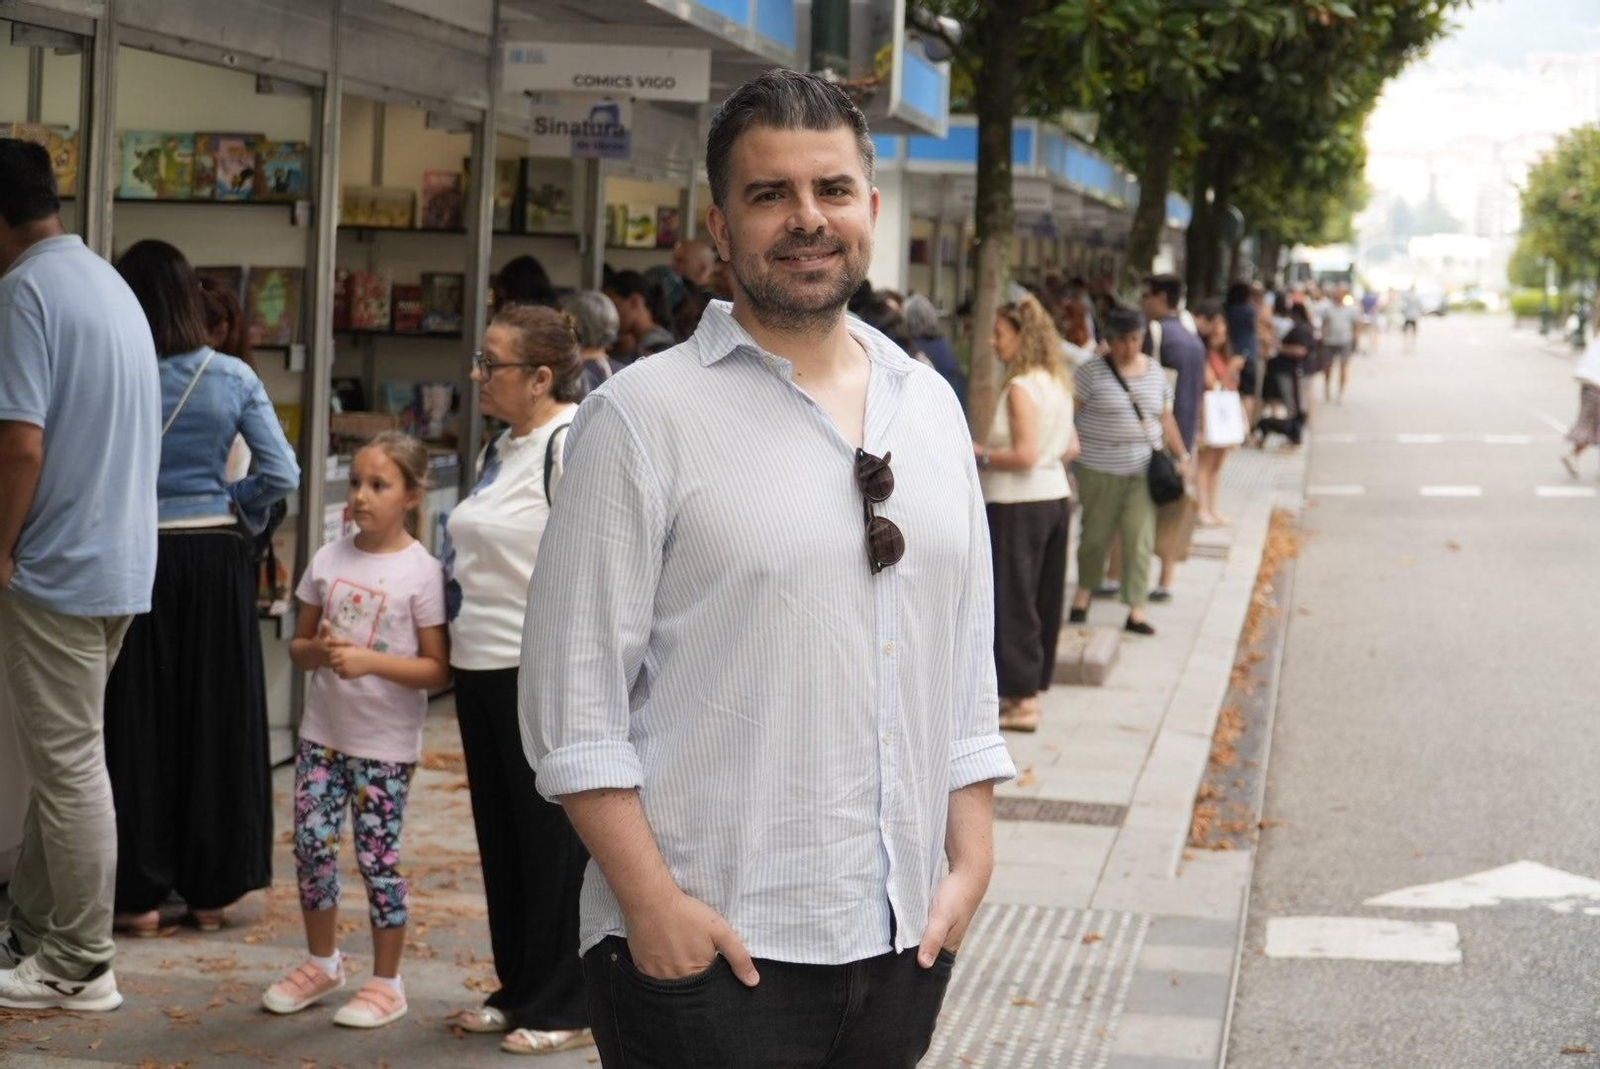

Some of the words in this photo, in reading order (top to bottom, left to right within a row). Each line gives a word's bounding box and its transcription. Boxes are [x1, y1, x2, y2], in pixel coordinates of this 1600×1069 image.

[573, 74, 634, 88] COMICS
[637, 75, 677, 89] VIGO
[535, 116, 626, 137] Sinatura
